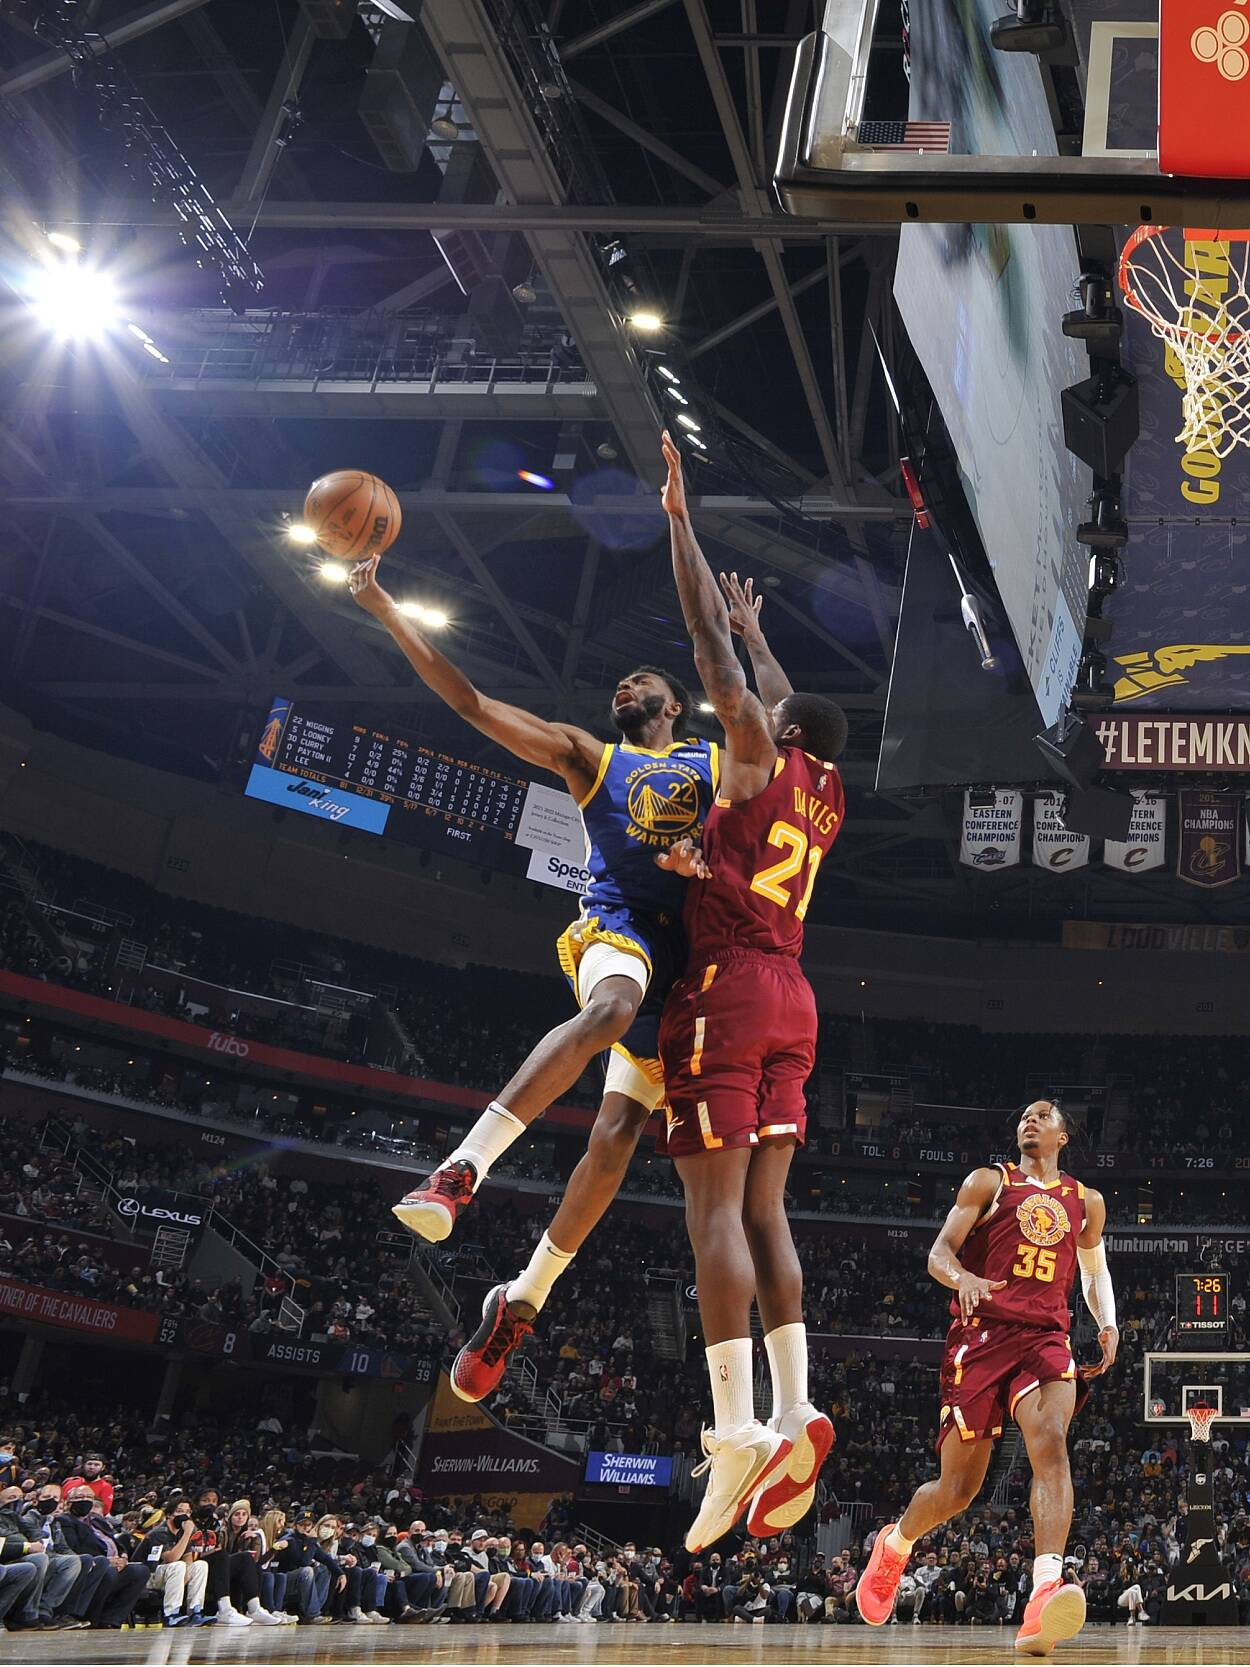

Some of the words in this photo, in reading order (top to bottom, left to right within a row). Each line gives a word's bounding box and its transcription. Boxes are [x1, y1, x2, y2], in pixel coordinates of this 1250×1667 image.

[1049, 615, 1065, 674] CLIFFS
[303, 728, 331, 744] LOONEY
[306, 720, 335, 735] WIGGINS
[300, 737, 325, 751] CURRY
[295, 755, 310, 766] LEE
[297, 747, 325, 762] PAYTON
[625, 762, 667, 784] GOLDEN
[668, 783, 694, 802] 22
[793, 786, 838, 835] DAVIS
[973, 809, 1012, 819] EASTERN
[1200, 809, 1218, 819] NBA
[965, 821, 1019, 830] CONFERENCE
[1130, 821, 1163, 831] ERENCE
[1184, 819, 1234, 830] CHAMPIONS
[966, 832, 1016, 842] CHAMPIONS
[547, 857, 592, 881] Spec
[750, 820, 823, 922] 21
[207, 1032, 249, 1057] fubo
[919, 1150, 954, 1162] FOULS
[1097, 1155, 1115, 1167] 35
[1184, 1157, 1214, 1168] 7:26
[141, 1205, 202, 1225] LEXUS
[1103, 1234, 1188, 1254] Huntington
[1013, 1244, 1057, 1282] 35
[1193, 1278, 1221, 1293] 7:26
[0, 1285, 24, 1309] TNER
[25, 1292, 39, 1312] OF
[39, 1295, 59, 1317] THE
[59, 1301, 118, 1329] CAVALIERS
[1195, 1295, 1218, 1316] 11
[1192, 1321, 1225, 1329] TISSOT
[159, 1328, 176, 1343] 52
[223, 1332, 236, 1354] 8
[266, 1344, 321, 1364] ASSISTS
[351, 1353, 369, 1373] 10
[601, 1453, 657, 1470] SHERWIN
[1166, 1583, 1230, 1601] KIA
